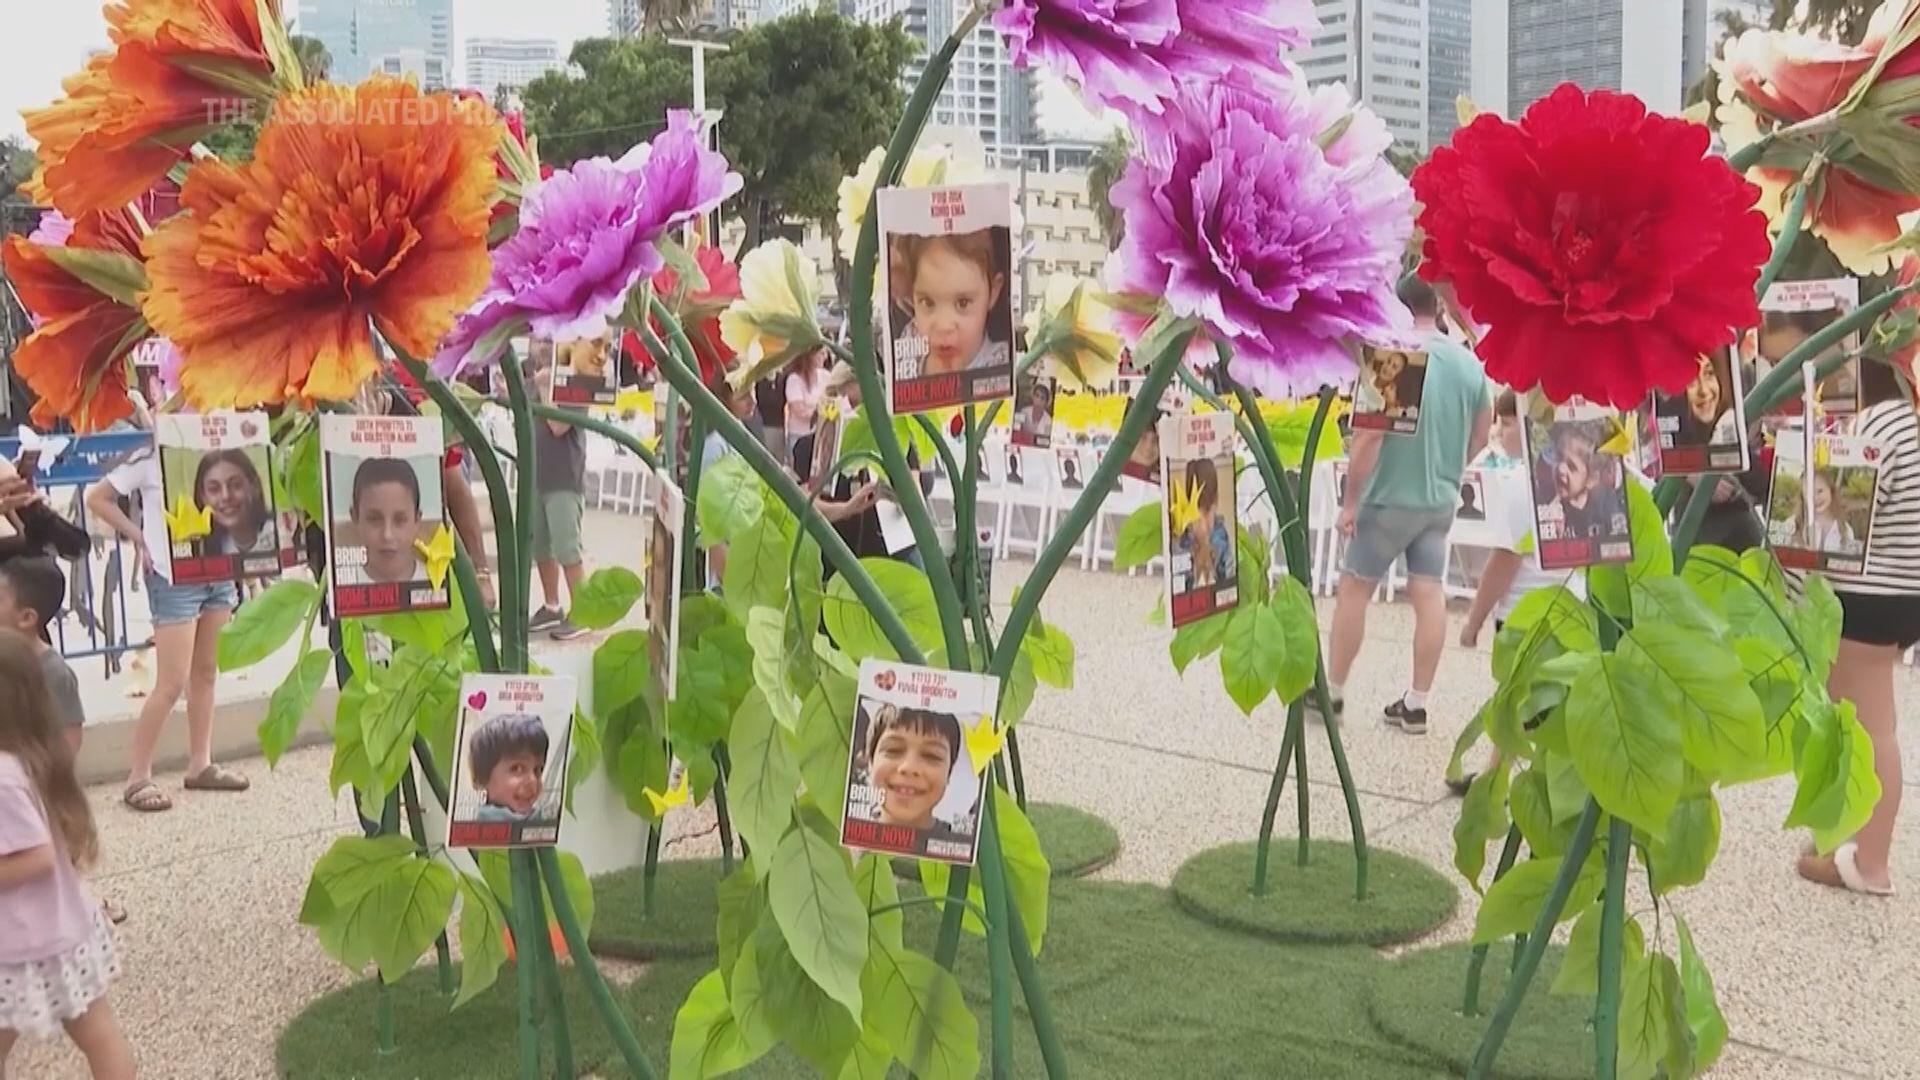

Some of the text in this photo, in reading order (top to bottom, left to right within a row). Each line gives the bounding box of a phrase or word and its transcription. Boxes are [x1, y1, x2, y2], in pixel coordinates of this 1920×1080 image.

[894, 336, 929, 358] BRING
[894, 359, 918, 379] HER
[896, 382, 927, 401] HOME
[335, 545, 368, 565] BRING
[850, 784, 886, 807] BRING
[848, 801, 872, 820] HIM
[846, 820, 916, 846] HOME NOW!
